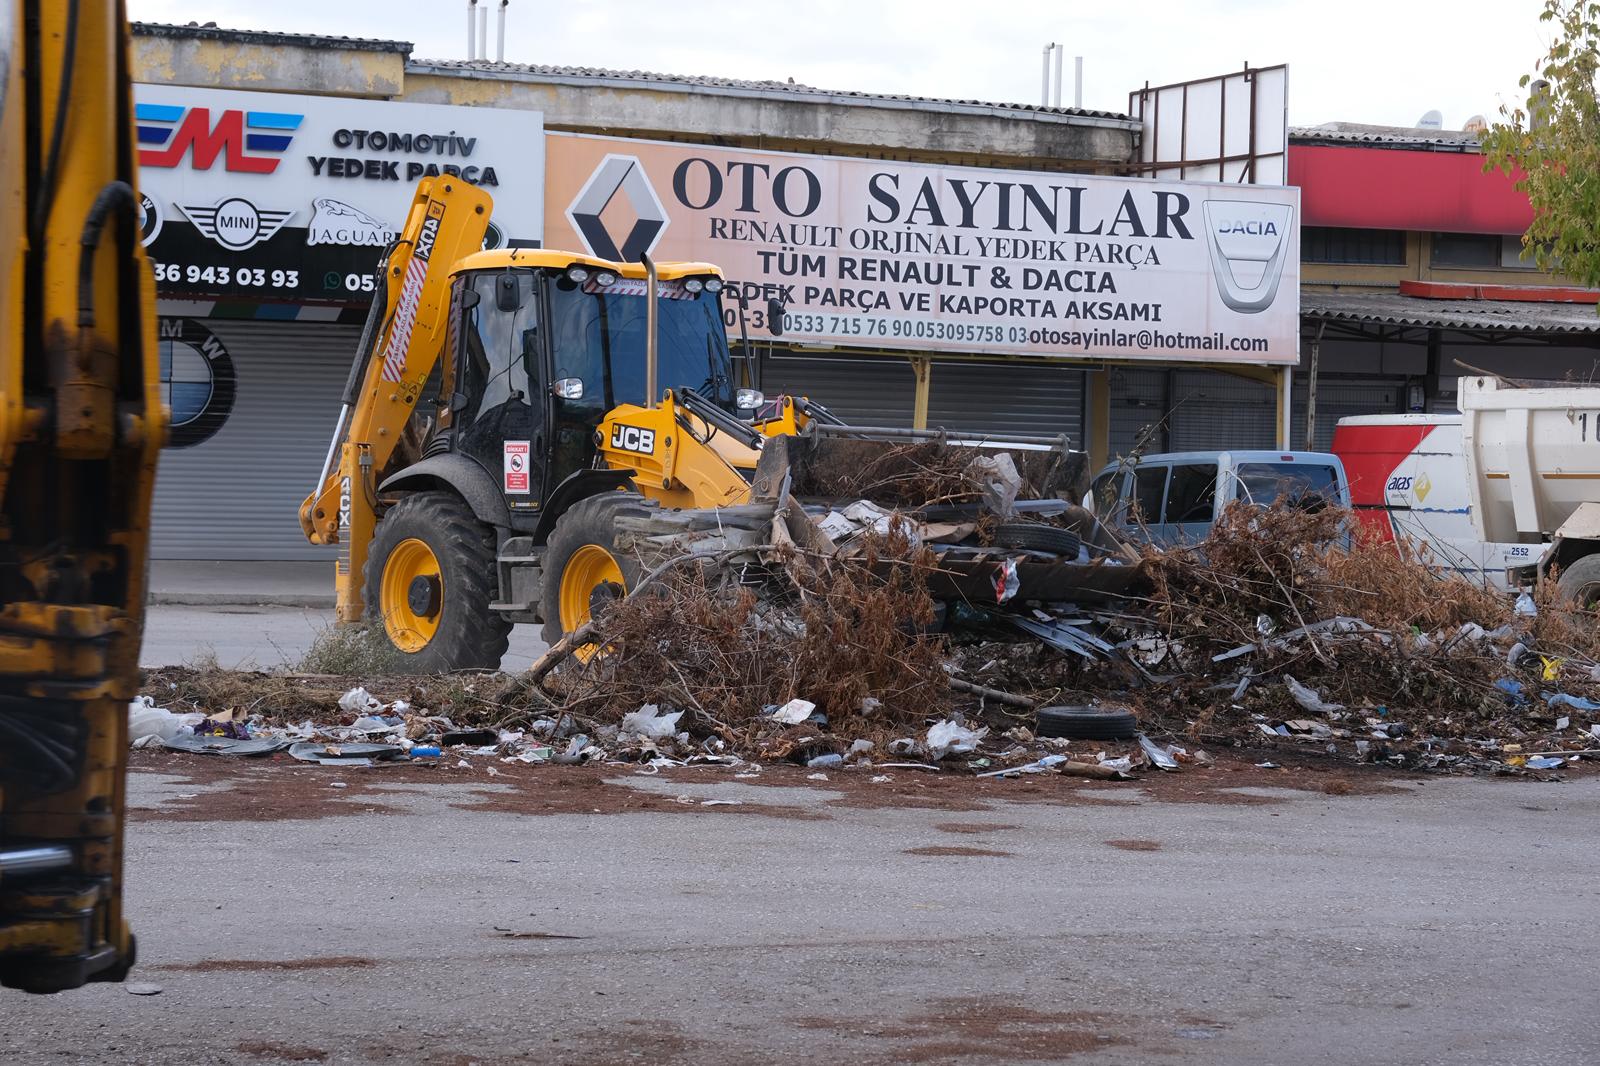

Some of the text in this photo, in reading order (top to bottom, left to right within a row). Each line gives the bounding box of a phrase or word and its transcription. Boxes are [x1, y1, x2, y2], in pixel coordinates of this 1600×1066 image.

[333, 129, 477, 157] OTOMOTİV
[308, 156, 400, 181] YEDEK
[673, 158, 1195, 240] OTO SAYINLAR
[220, 216, 254, 229] MINI
[311, 228, 393, 243] JAGUAR
[1218, 219, 1278, 237] DACIA
[415, 219, 438, 260] 4CX
[709, 217, 1161, 270] RENAULT ORJİNAL YEDEK PARÇA
[154, 263, 299, 289] 36 943 03 93
[757, 246, 1117, 293] TÜM RENAULT & DACIA
[726, 281, 1162, 322] EDEK PARÇA VE KAPORTA AKSAMI
[783, 313, 824, 333] 0533
[830, 317, 861, 335] 715
[867, 319, 887, 336] 76
[611, 427, 654, 453] JCB
[1387, 476, 1412, 491] aras
[339, 477, 351, 526] 4CX
